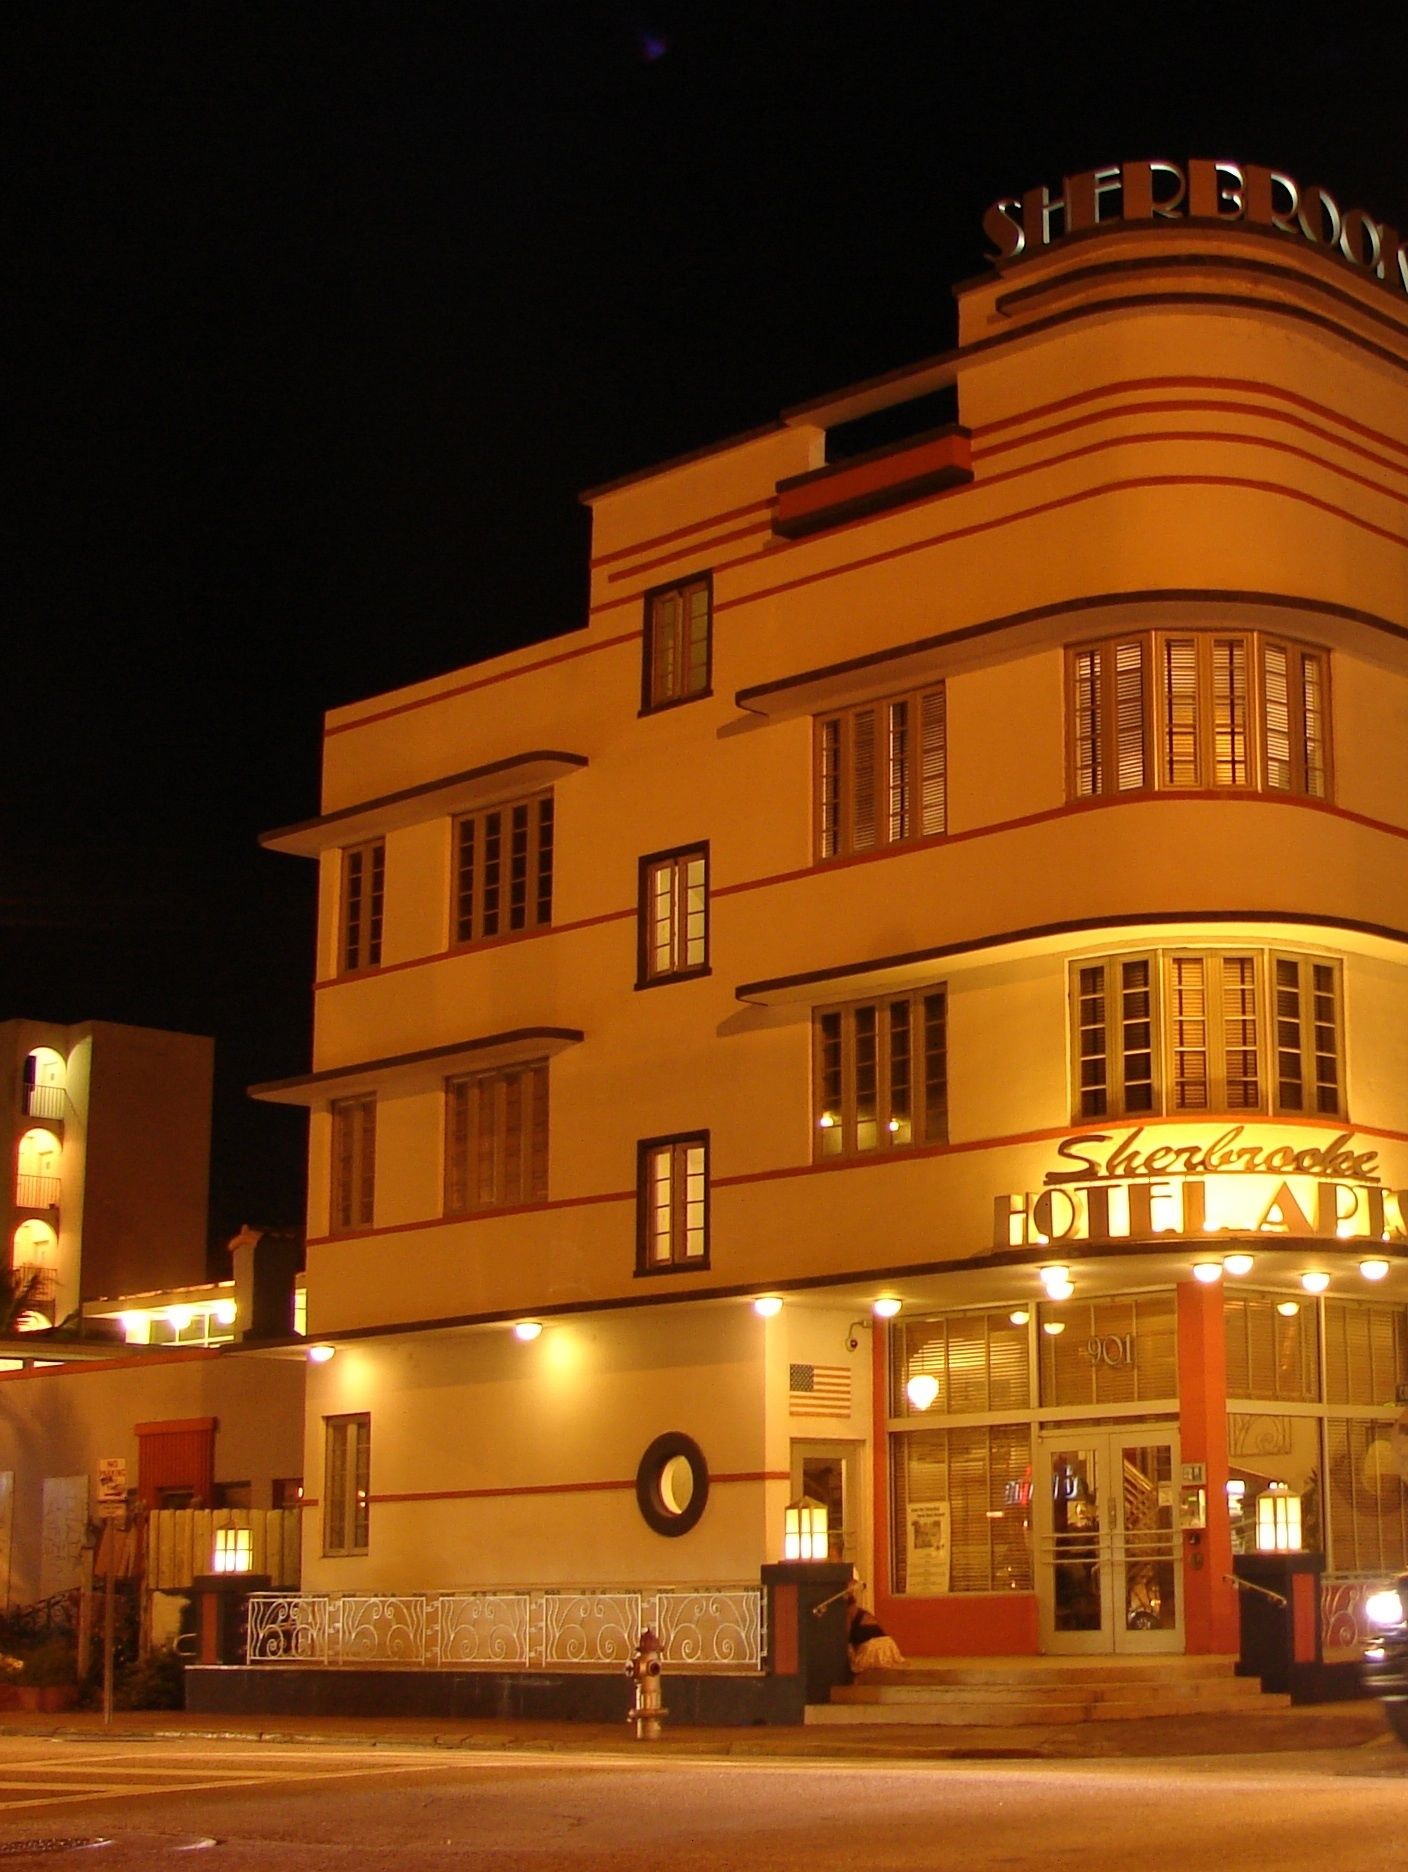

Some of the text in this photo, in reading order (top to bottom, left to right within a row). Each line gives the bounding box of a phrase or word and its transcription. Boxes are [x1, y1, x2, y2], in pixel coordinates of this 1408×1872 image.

[1044, 1126, 1381, 1184] Sherbrooke
[994, 1180, 1256, 1247] HOTEL
[1087, 1333, 1133, 1366] 901
